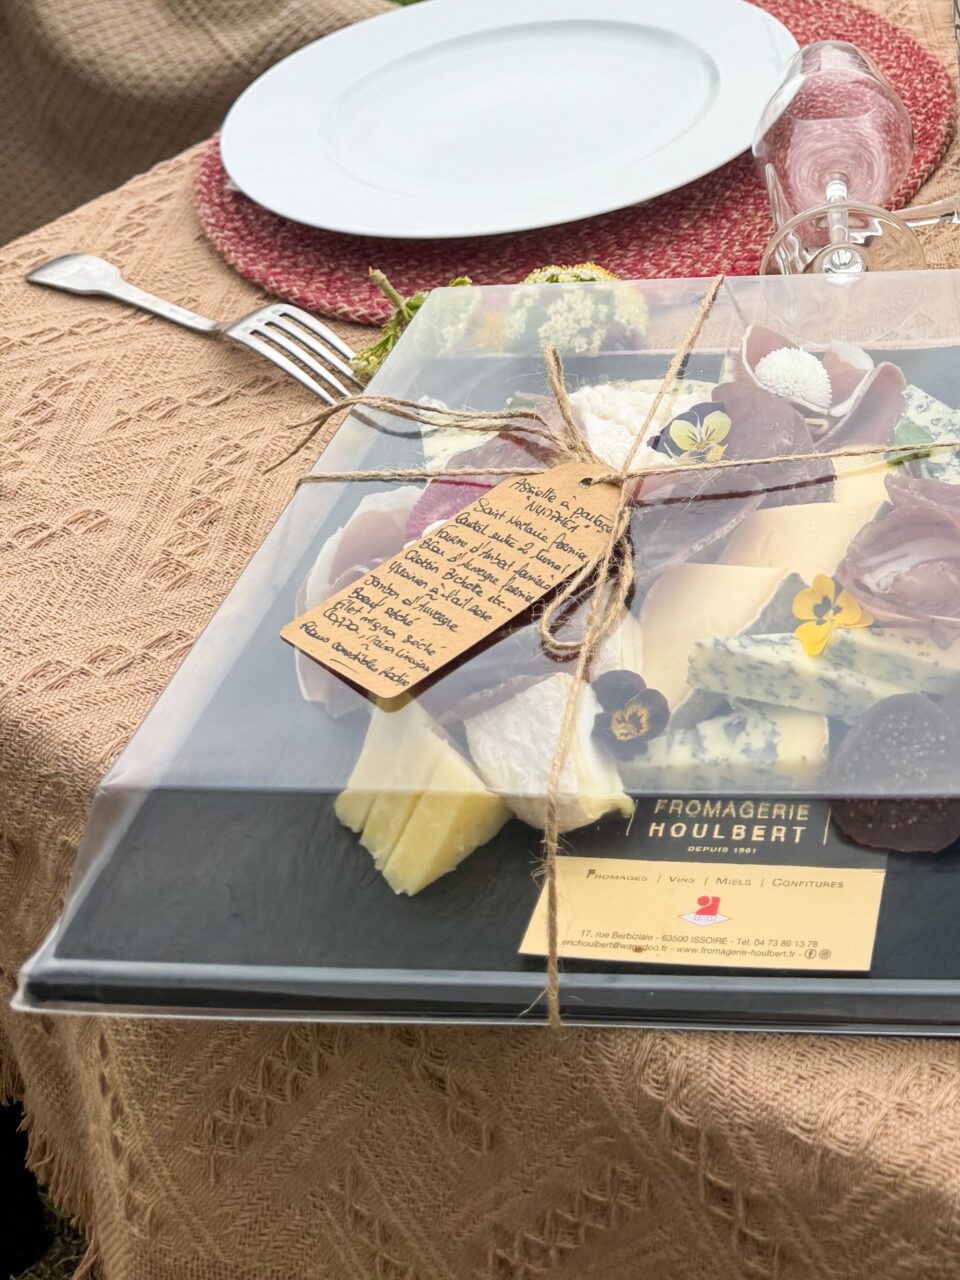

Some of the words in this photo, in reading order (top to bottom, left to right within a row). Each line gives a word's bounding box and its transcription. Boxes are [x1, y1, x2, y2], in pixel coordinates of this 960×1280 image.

[474, 498, 506, 521] Saint
[517, 542, 535, 555] 2
[653, 799, 811, 821] FROMAGERIE
[648, 822, 806, 844] HOULBERT
[687, 845, 728, 854] DEPUIS
[691, 936, 728, 945] ISSOIRE
[754, 939, 765, 947] 04
